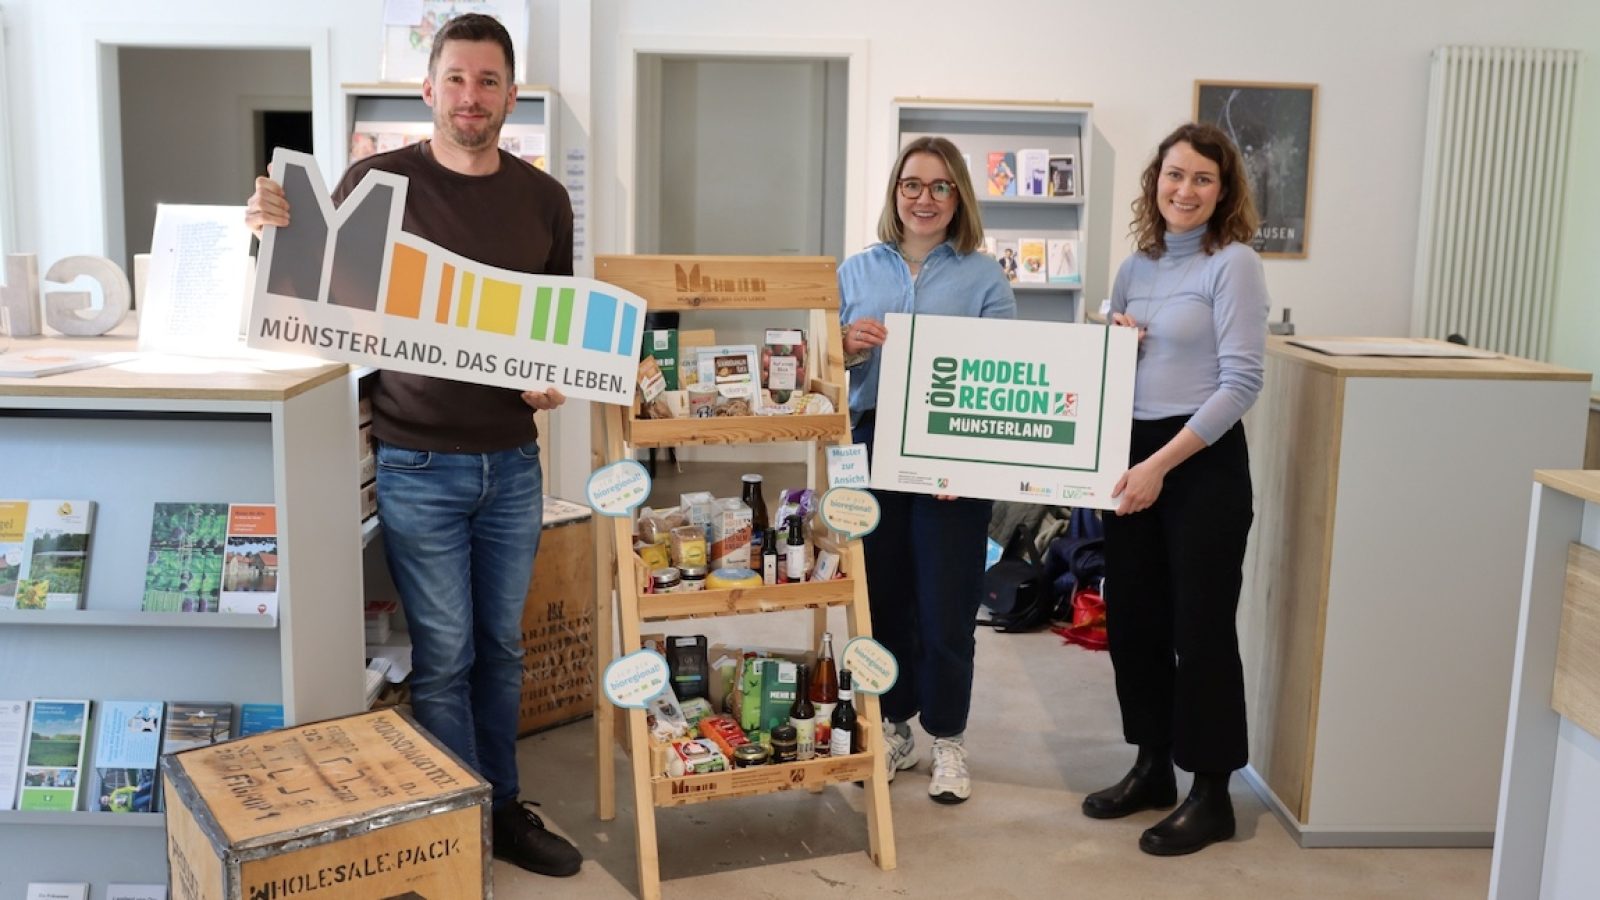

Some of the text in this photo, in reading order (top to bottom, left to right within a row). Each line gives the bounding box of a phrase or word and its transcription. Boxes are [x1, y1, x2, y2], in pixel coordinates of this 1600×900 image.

[260, 316, 627, 394] MÜNSTERLAND. DAS GUTE LEBEN.
[961, 359, 1049, 386] MODELL
[925, 357, 957, 407] ÖKO
[958, 386, 1049, 414] REGION
[834, 475, 865, 484] Ansicht
[250, 838, 462, 900] WHOLESALE PACK
